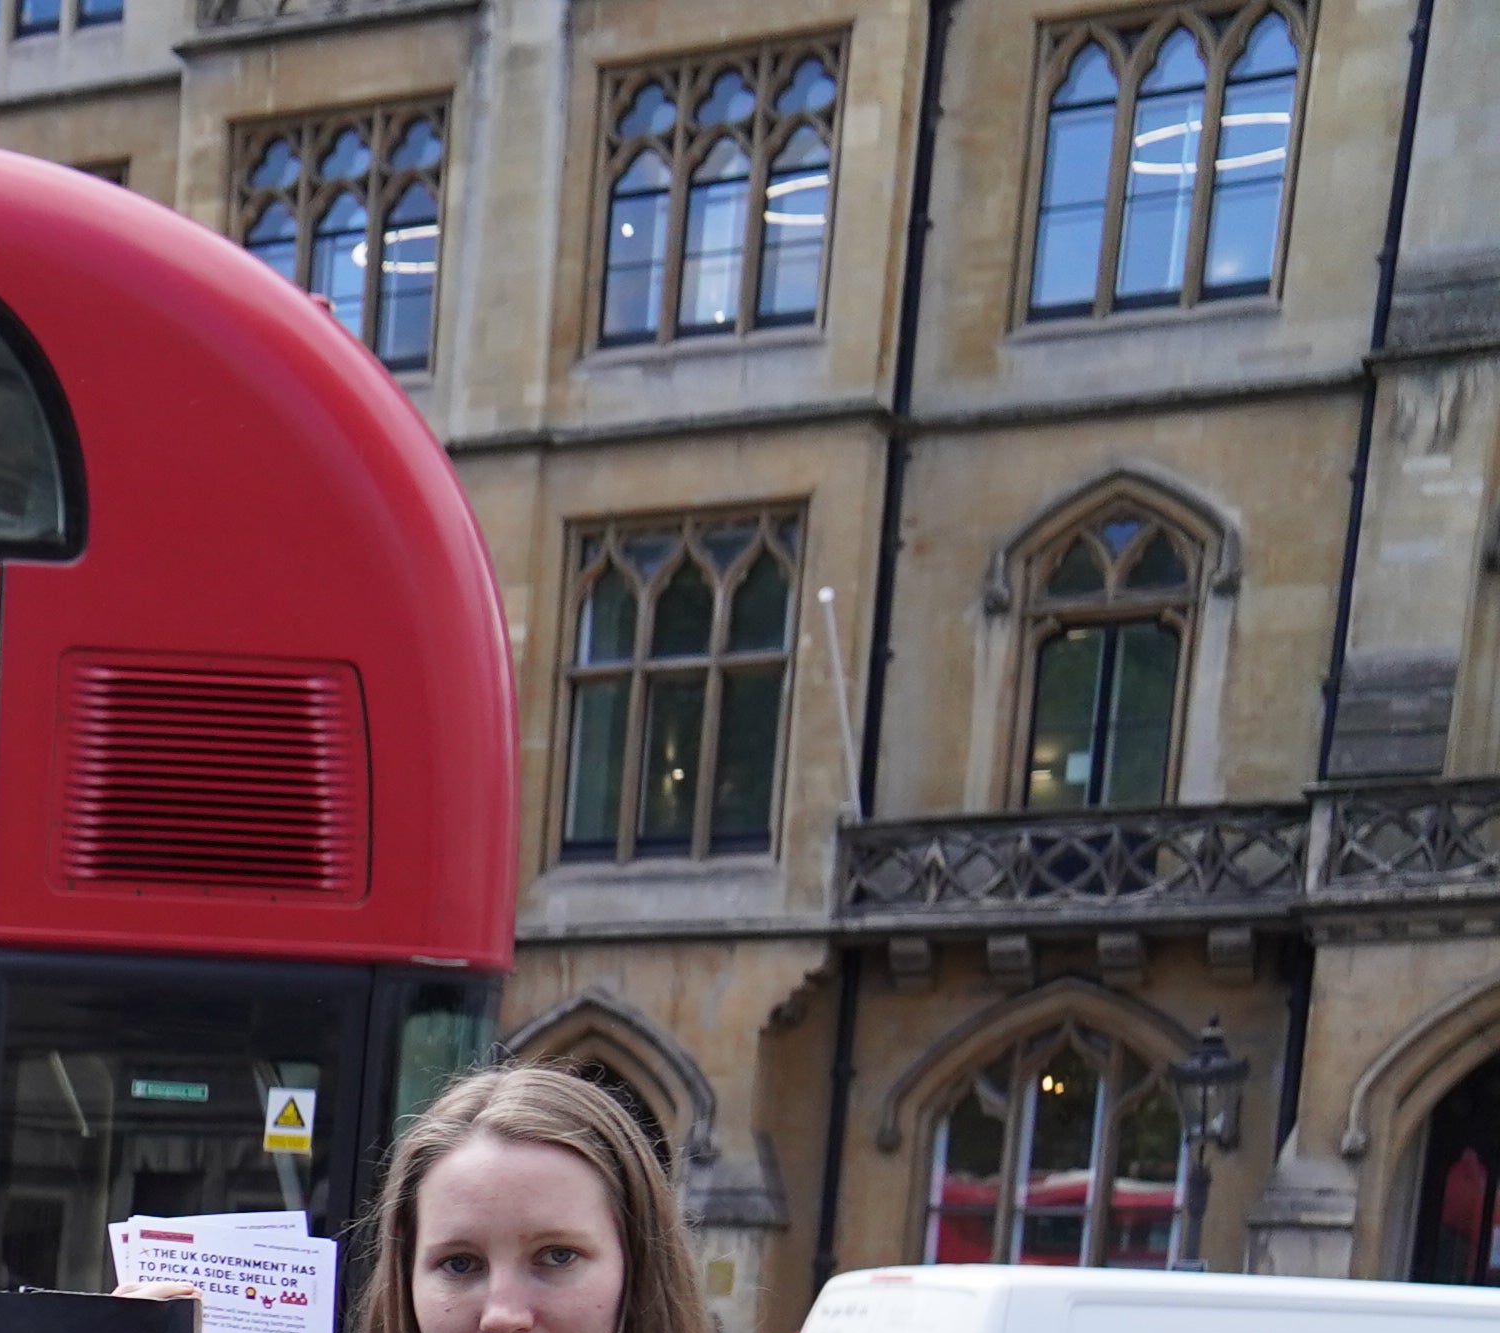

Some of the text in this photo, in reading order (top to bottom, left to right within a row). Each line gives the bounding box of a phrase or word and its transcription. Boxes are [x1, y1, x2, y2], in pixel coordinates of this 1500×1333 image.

[139, 1261, 156, 1271] TO
[160, 1263, 188, 1275] PICK
[192, 1267, 200, 1276] A
[239, 1272, 277, 1287] SHELL
[281, 1277, 298, 1288] OR
[153, 1248, 316, 1276] THE UK GOVERNMENT HAS
[210, 1282, 239, 1296] ELSE
